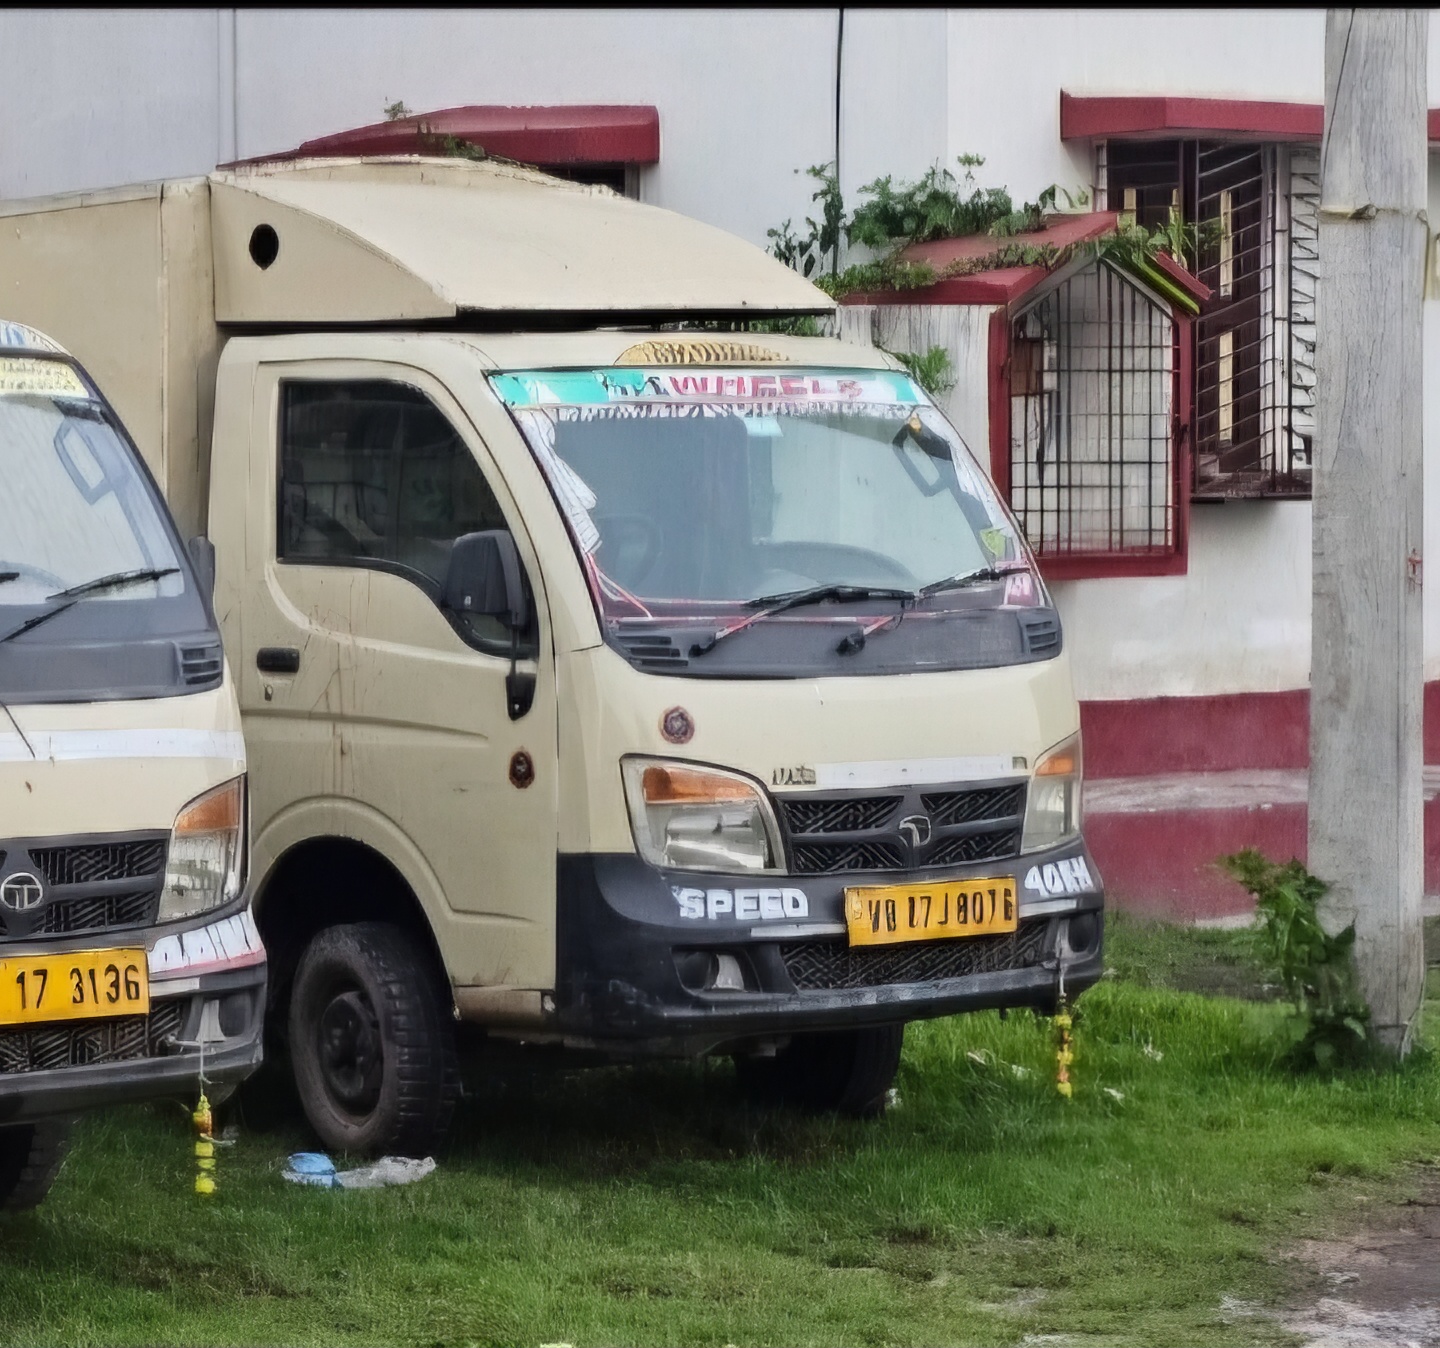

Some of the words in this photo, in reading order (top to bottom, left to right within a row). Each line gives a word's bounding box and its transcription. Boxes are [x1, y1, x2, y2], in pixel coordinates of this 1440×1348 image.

[678, 886, 809, 921] SPEED
[15, 968, 48, 1011] 17
[69, 963, 141, 1005] 3136
